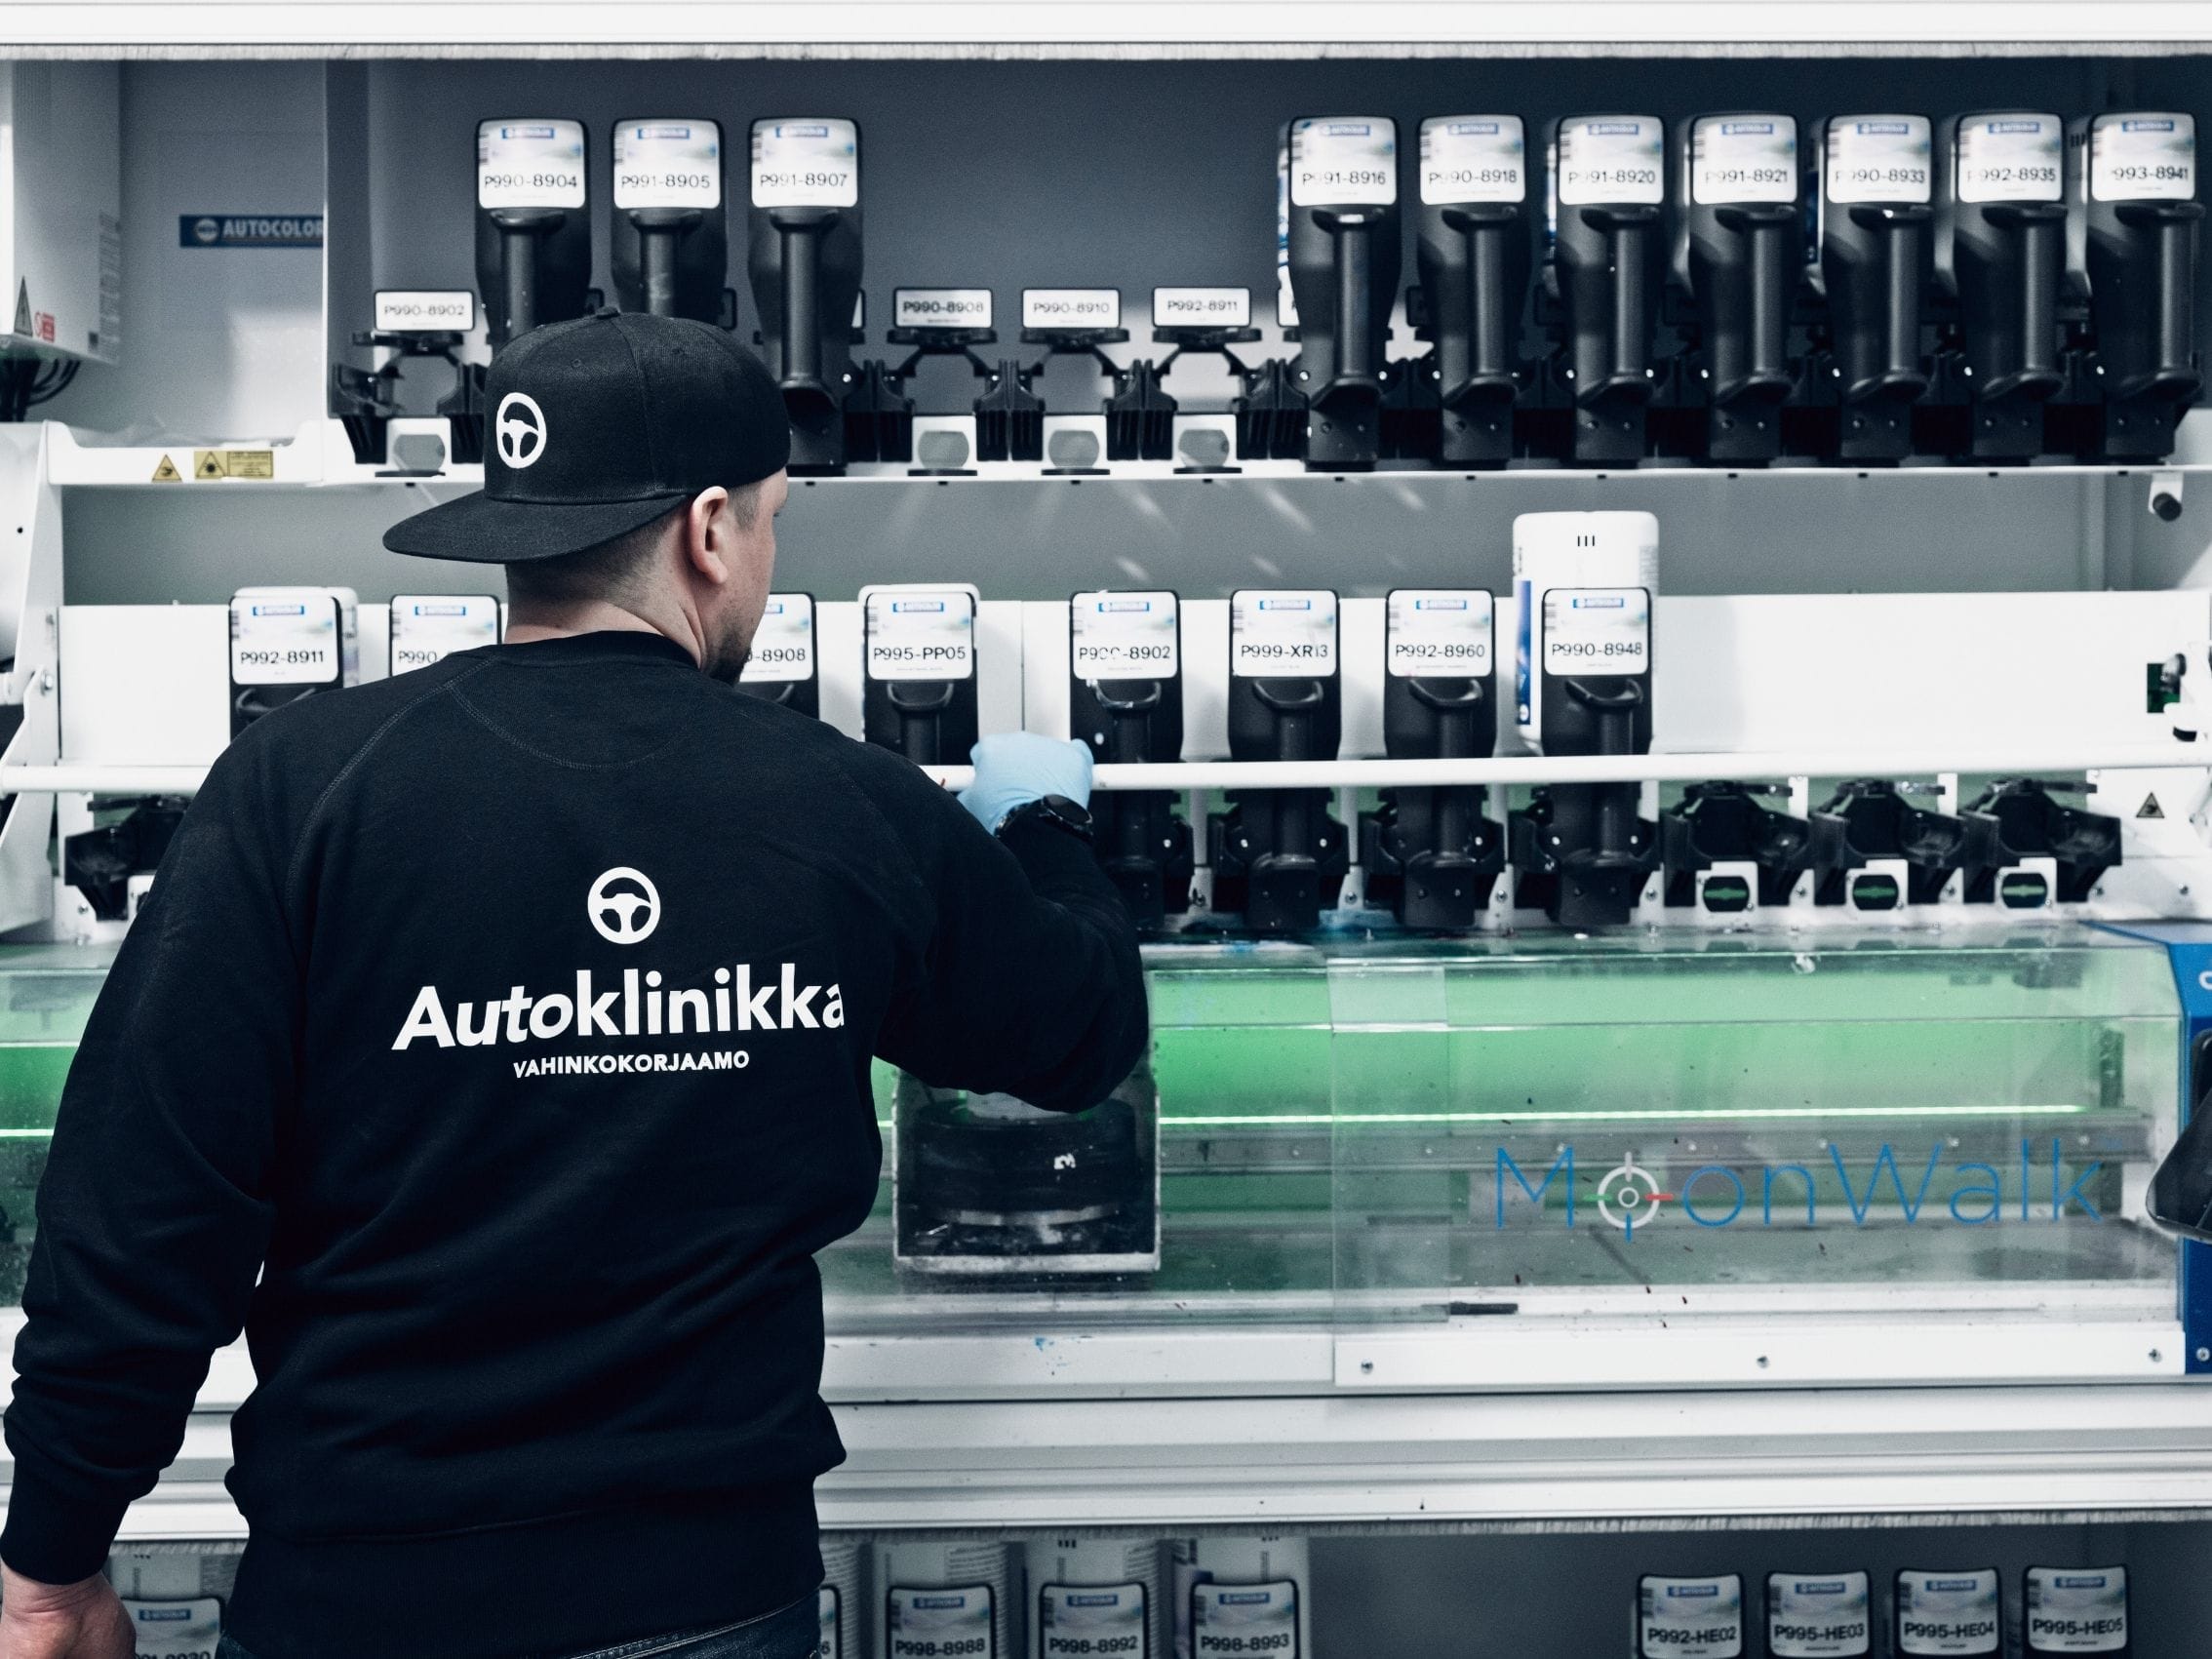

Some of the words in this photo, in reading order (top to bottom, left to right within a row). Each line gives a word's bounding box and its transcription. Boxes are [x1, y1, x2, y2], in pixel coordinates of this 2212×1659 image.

[760, 172, 849, 187] P991-8907
[1835, 168, 1926, 184] P90-8933
[2110, 165, 2189, 181] 993-8941
[484, 174, 578, 189] P990-8904
[621, 174, 711, 189] P991-8905
[240, 650, 325, 664] P992-8911
[873, 646, 967, 661] P995-PP05
[1395, 644, 1485, 658] P992-8960
[1552, 642, 1643, 657] P990-8948
[391, 963, 845, 1051] Autoklinikka
[513, 1050, 750, 1079] VAHINKOKORJAAMO
[1773, 1623, 1866, 1641] P995-HE03
[1904, 1620, 1995, 1639] P995-HE04
[2033, 1617, 2124, 1636] P995-HE05
[1200, 1633, 1290, 1652] P998-8993
[1647, 1626, 1737, 1644] P992-HE02
[1048, 1635, 1139, 1654] P998-8992
